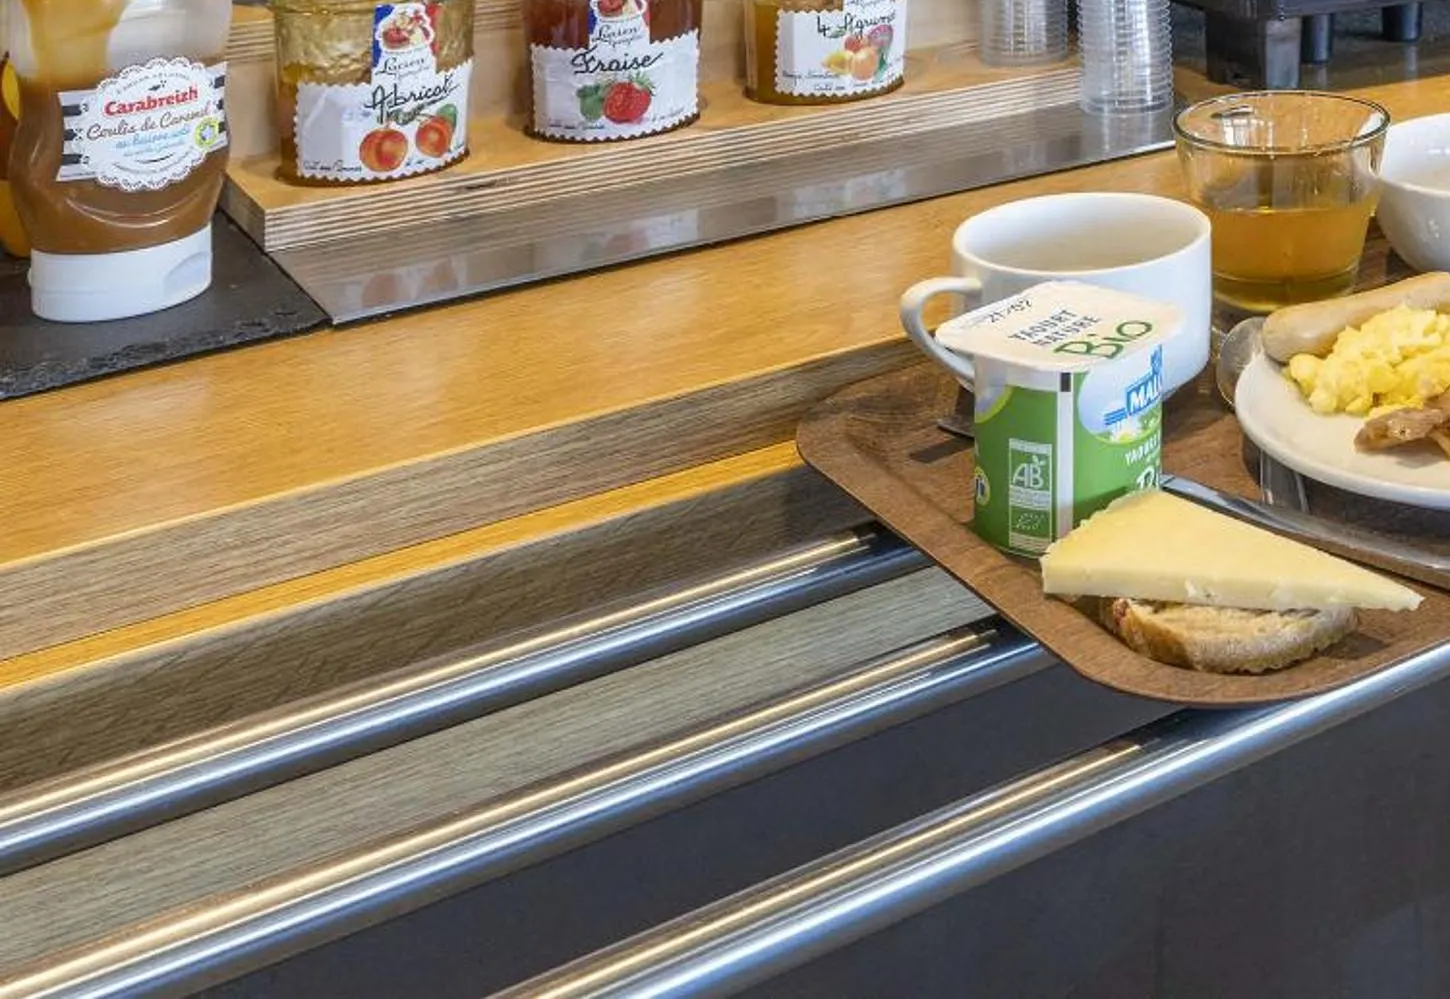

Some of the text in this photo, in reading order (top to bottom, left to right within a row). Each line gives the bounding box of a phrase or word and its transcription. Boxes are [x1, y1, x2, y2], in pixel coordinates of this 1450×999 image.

[571, 45, 664, 75] Fraise
[86, 119, 136, 140] Coulis
[140, 117, 157, 132] de
